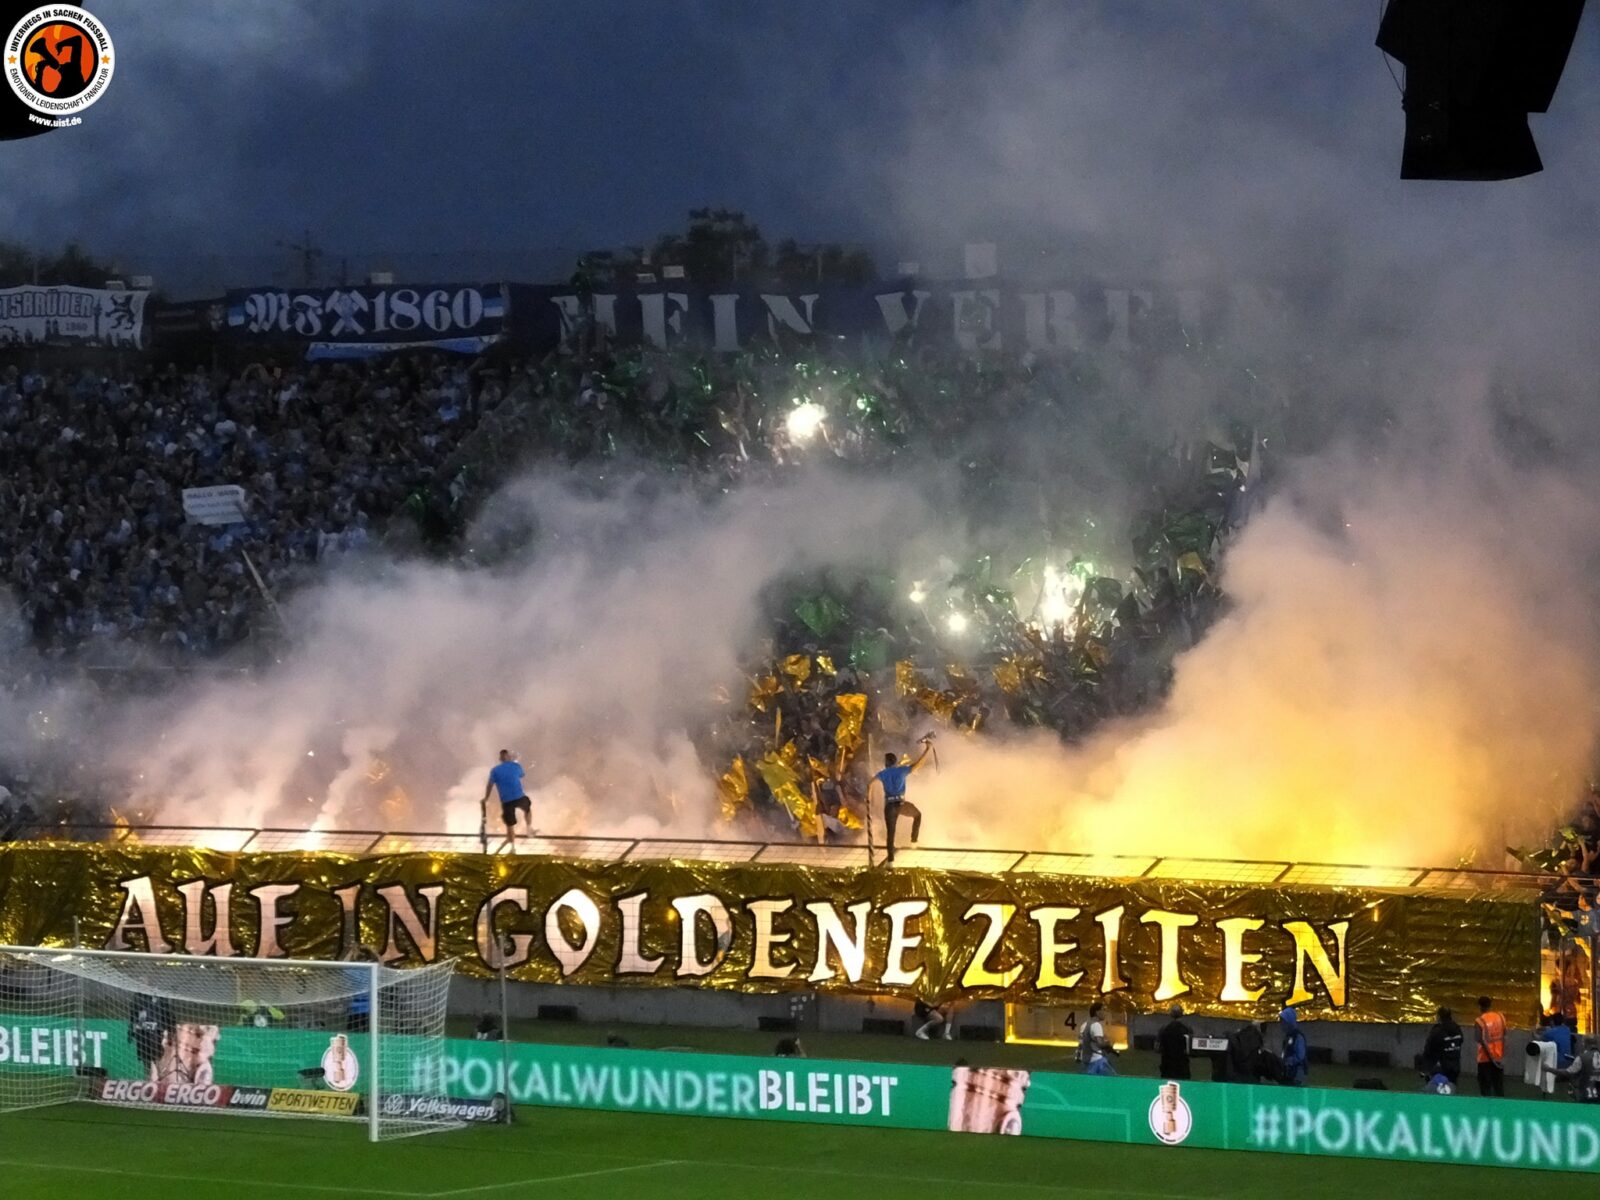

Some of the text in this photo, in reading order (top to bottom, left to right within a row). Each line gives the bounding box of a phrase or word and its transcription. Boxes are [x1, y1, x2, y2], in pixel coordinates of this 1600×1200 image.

[371, 288, 483, 333] 1860
[106, 876, 1350, 1008] AUF IN GOLDENE ZEITEN
[1064, 1011, 1077, 1031] 4
[102, 1080, 221, 1105] ERGO ERGO
[231, 1087, 356, 1112] bwin SPORTWETTEN
[408, 1097, 496, 1120] Volkswagen
